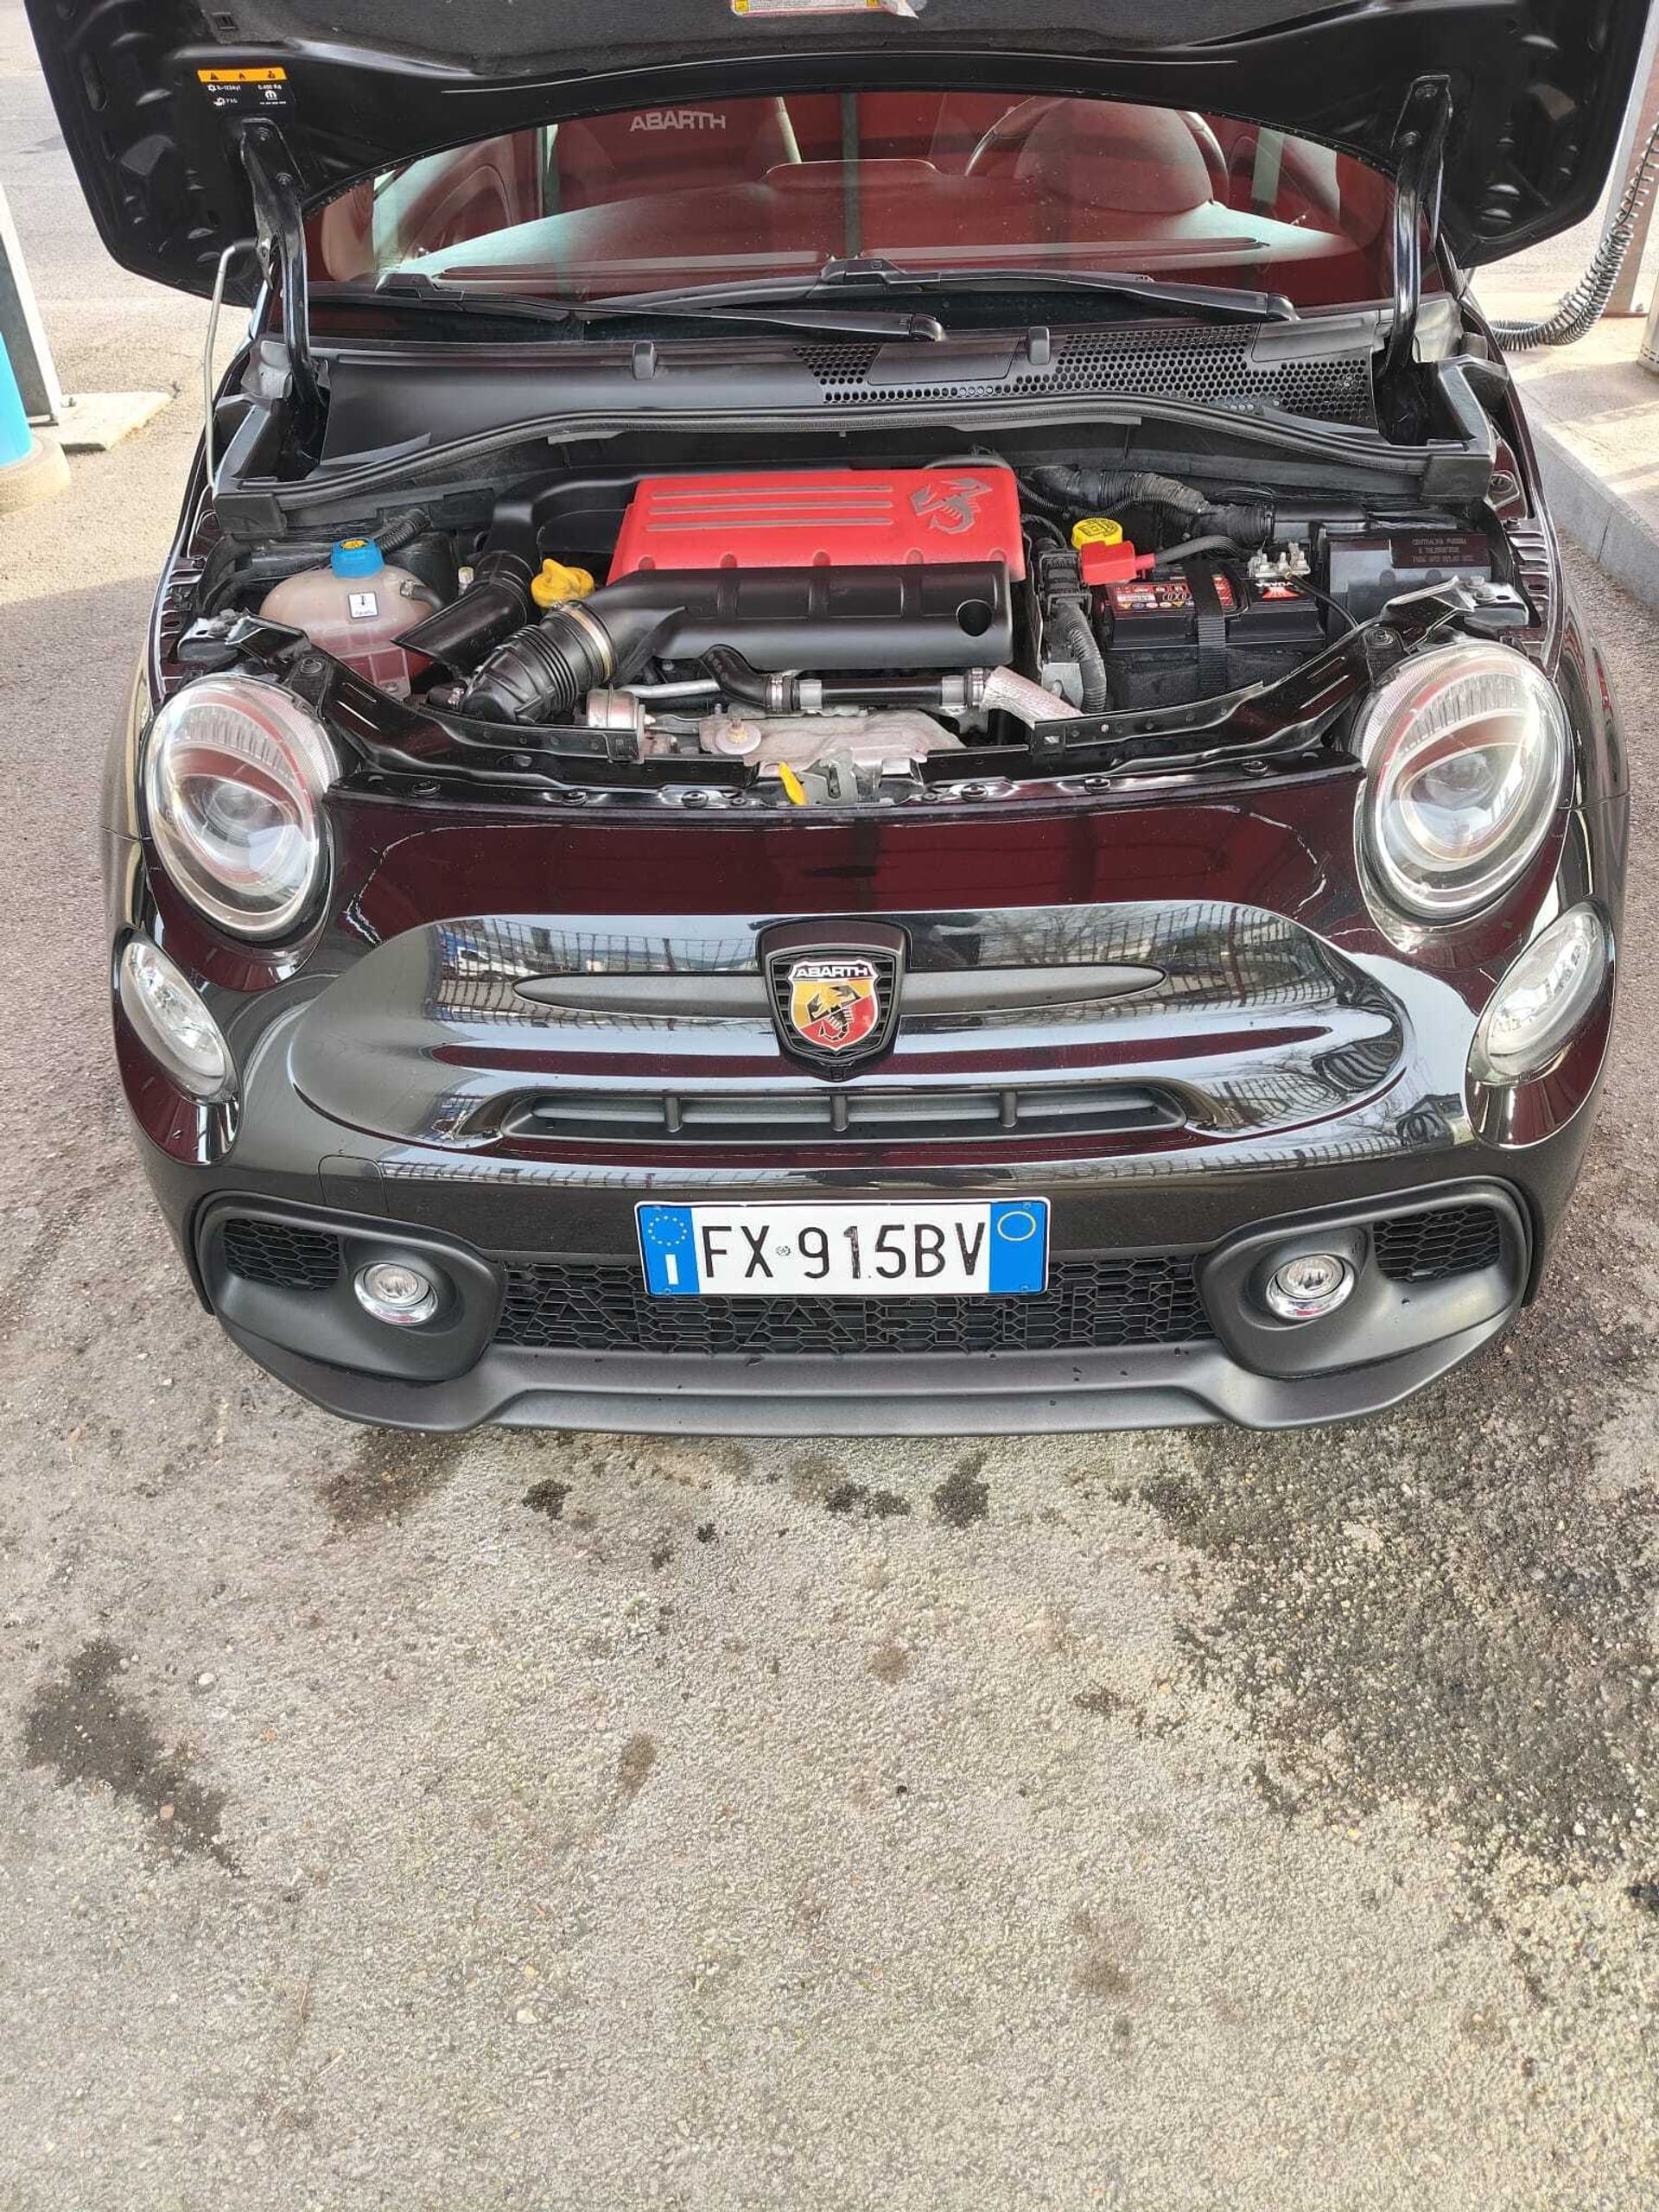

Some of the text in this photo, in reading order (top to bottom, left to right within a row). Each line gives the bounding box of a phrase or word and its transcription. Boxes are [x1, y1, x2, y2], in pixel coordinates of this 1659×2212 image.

[629, 110, 726, 132] ABARTH
[796, 966, 868, 978] ABARTH
[702, 1222, 987, 1280] FX 915BV
